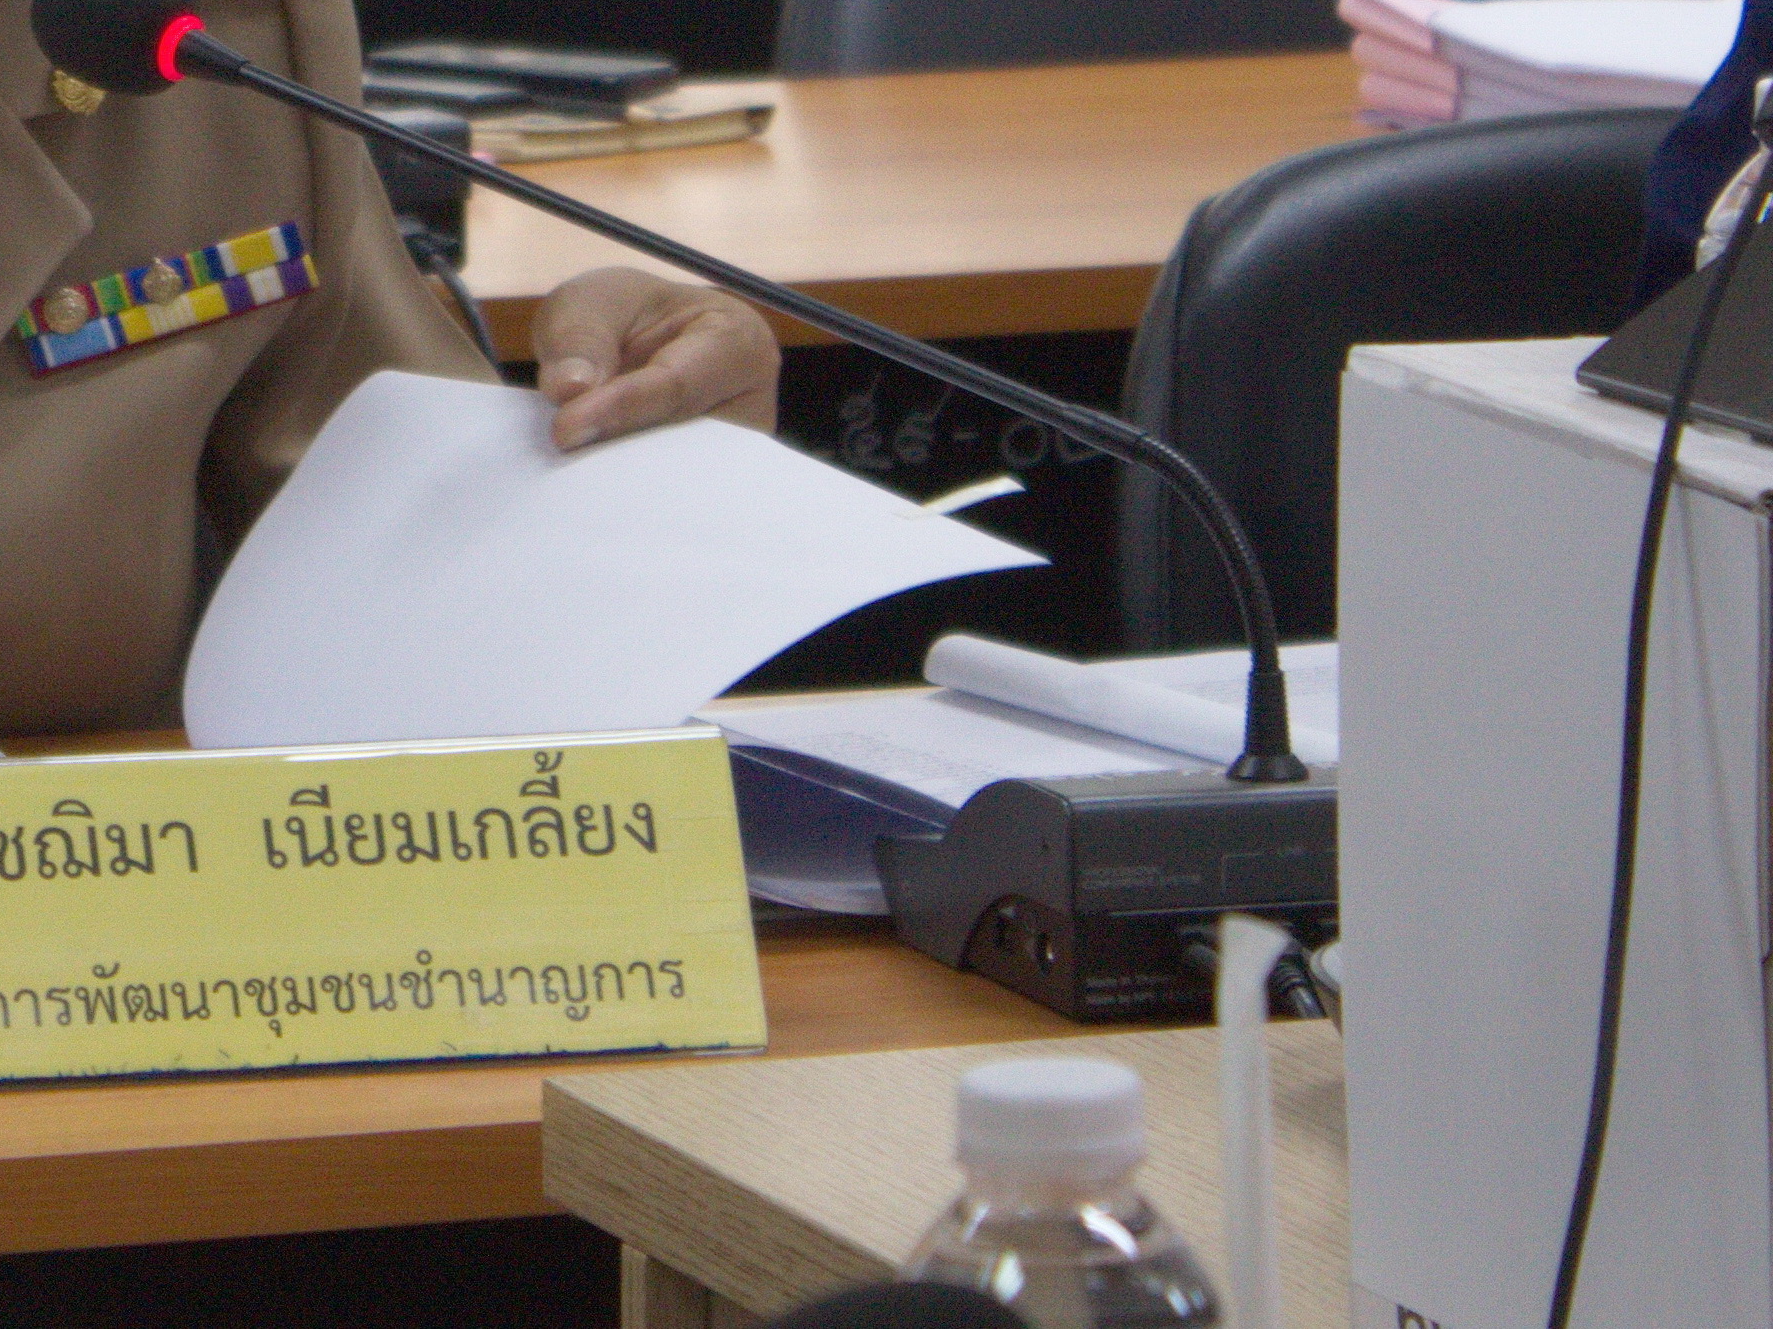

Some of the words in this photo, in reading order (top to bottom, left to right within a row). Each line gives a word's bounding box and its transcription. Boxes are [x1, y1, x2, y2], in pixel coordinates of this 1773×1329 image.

[262, 752, 657, 869] เนียมเกลี้ยง
